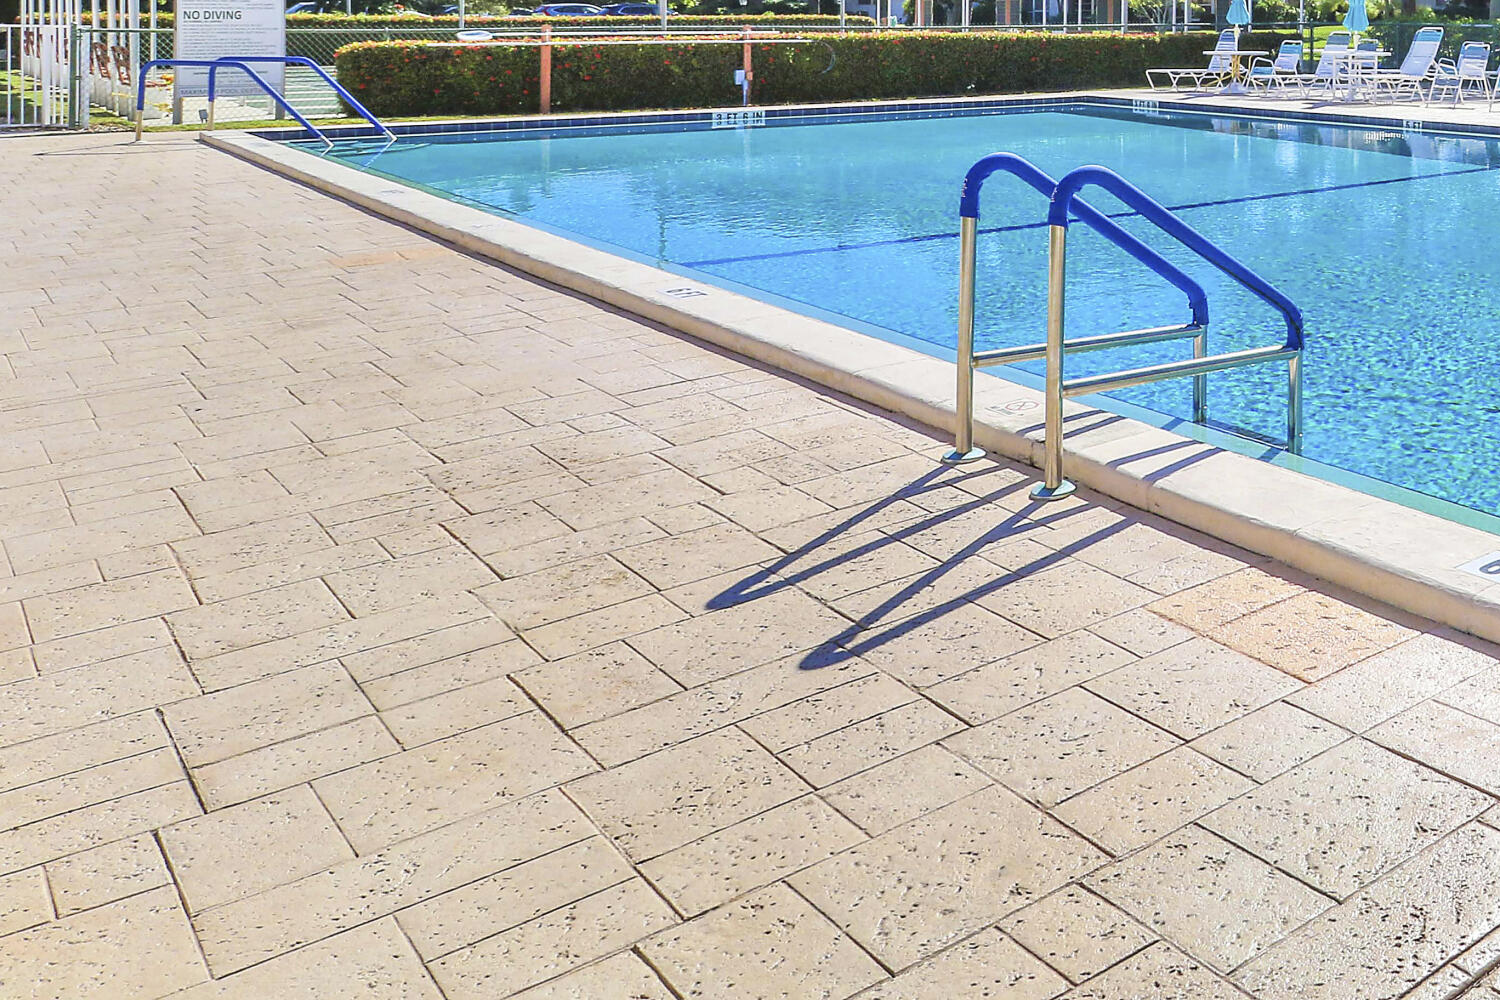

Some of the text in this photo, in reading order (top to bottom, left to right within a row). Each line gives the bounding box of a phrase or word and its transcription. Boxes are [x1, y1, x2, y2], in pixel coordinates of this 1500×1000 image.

[183, 10, 242, 20] NO DIVING
[727, 112, 738, 120] FT
[752, 111, 763, 119] IN
